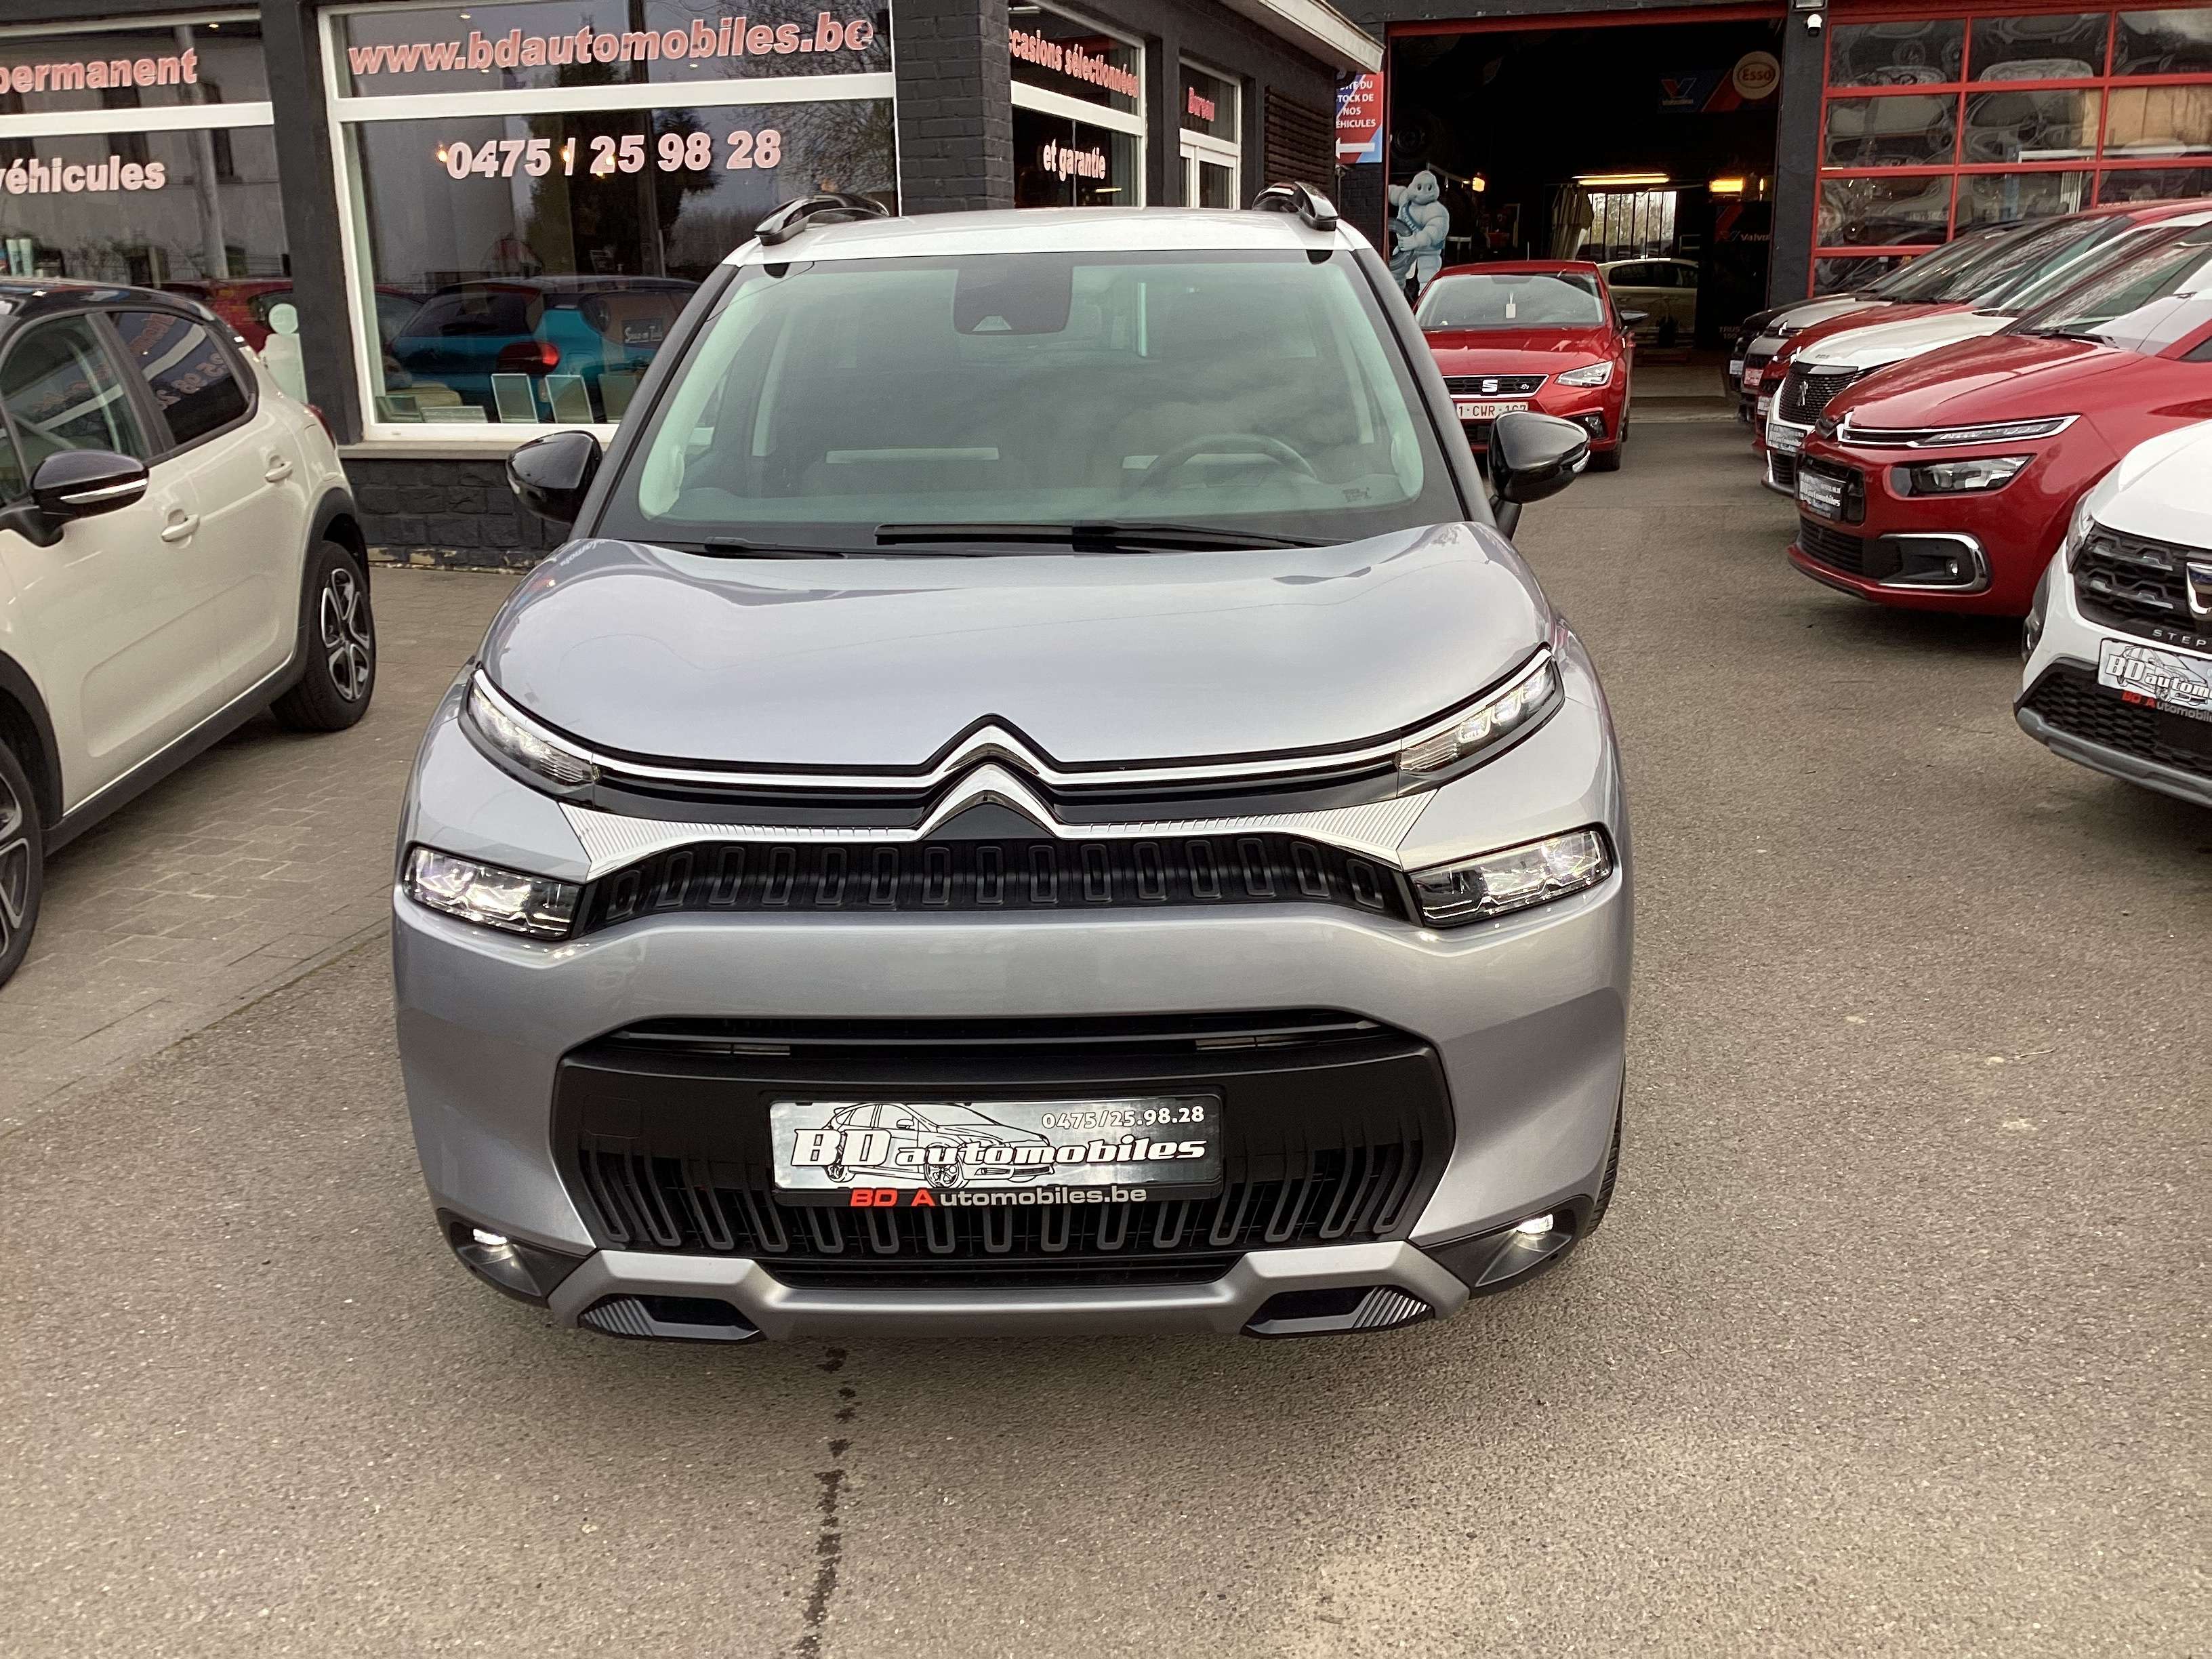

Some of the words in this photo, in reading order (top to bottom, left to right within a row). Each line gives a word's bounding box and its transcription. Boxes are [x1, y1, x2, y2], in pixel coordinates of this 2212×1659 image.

[348, 12, 874, 75] www.bdautomobiles.be
[1359, 80, 1373, 89] DU
[1337, 94, 1361, 103] TOCK
[1362, 94, 1374, 102] DE
[1343, 106, 1361, 116] NOS
[1336, 118, 1376, 129] ÉHICULES
[446, 138, 551, 180] 0475
[590, 134, 644, 174] 25
[657, 132, 711, 172] 98
[726, 129, 781, 169] 28
[1044, 138, 1057, 172] et
[1059, 146, 1106, 182] garantie
[2152, 629, 2207, 647] STEP
[2106, 654, 2145, 681] BD
[2145, 674, 2212, 699] autom
[1041, 1105, 1205, 1130] 0475/25.98.28
[791, 1128, 892, 1166] BD
[895, 1134, 1208, 1166] automobiles
[851, 1188, 899, 1207] BD
